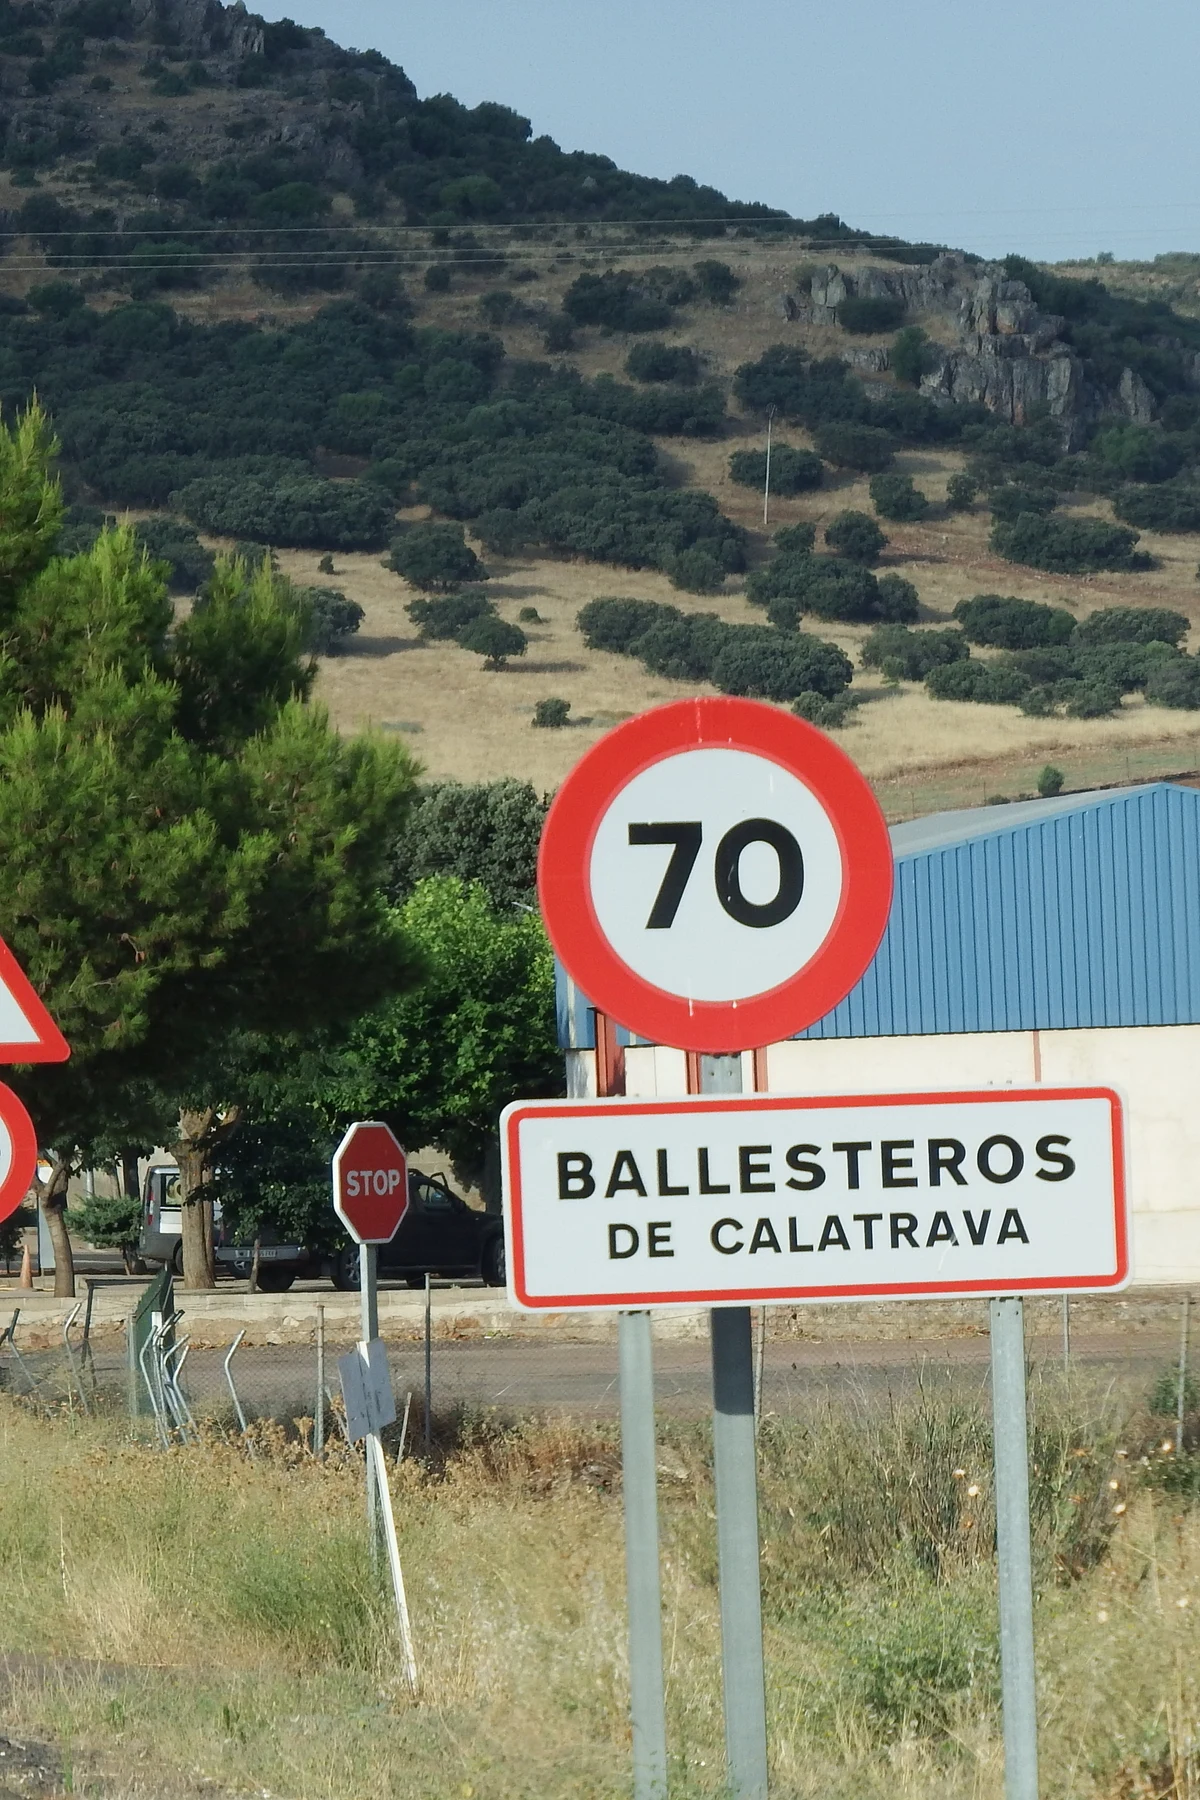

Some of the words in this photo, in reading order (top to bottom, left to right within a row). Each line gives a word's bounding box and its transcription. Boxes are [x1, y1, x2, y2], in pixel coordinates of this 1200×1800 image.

[628, 818, 805, 930] 70
[346, 1169, 400, 1196] STOP
[557, 1134, 1076, 1200] BALLESTEROS
[608, 1221, 675, 1260] DE
[710, 1208, 1030, 1255] CALATRAVA
